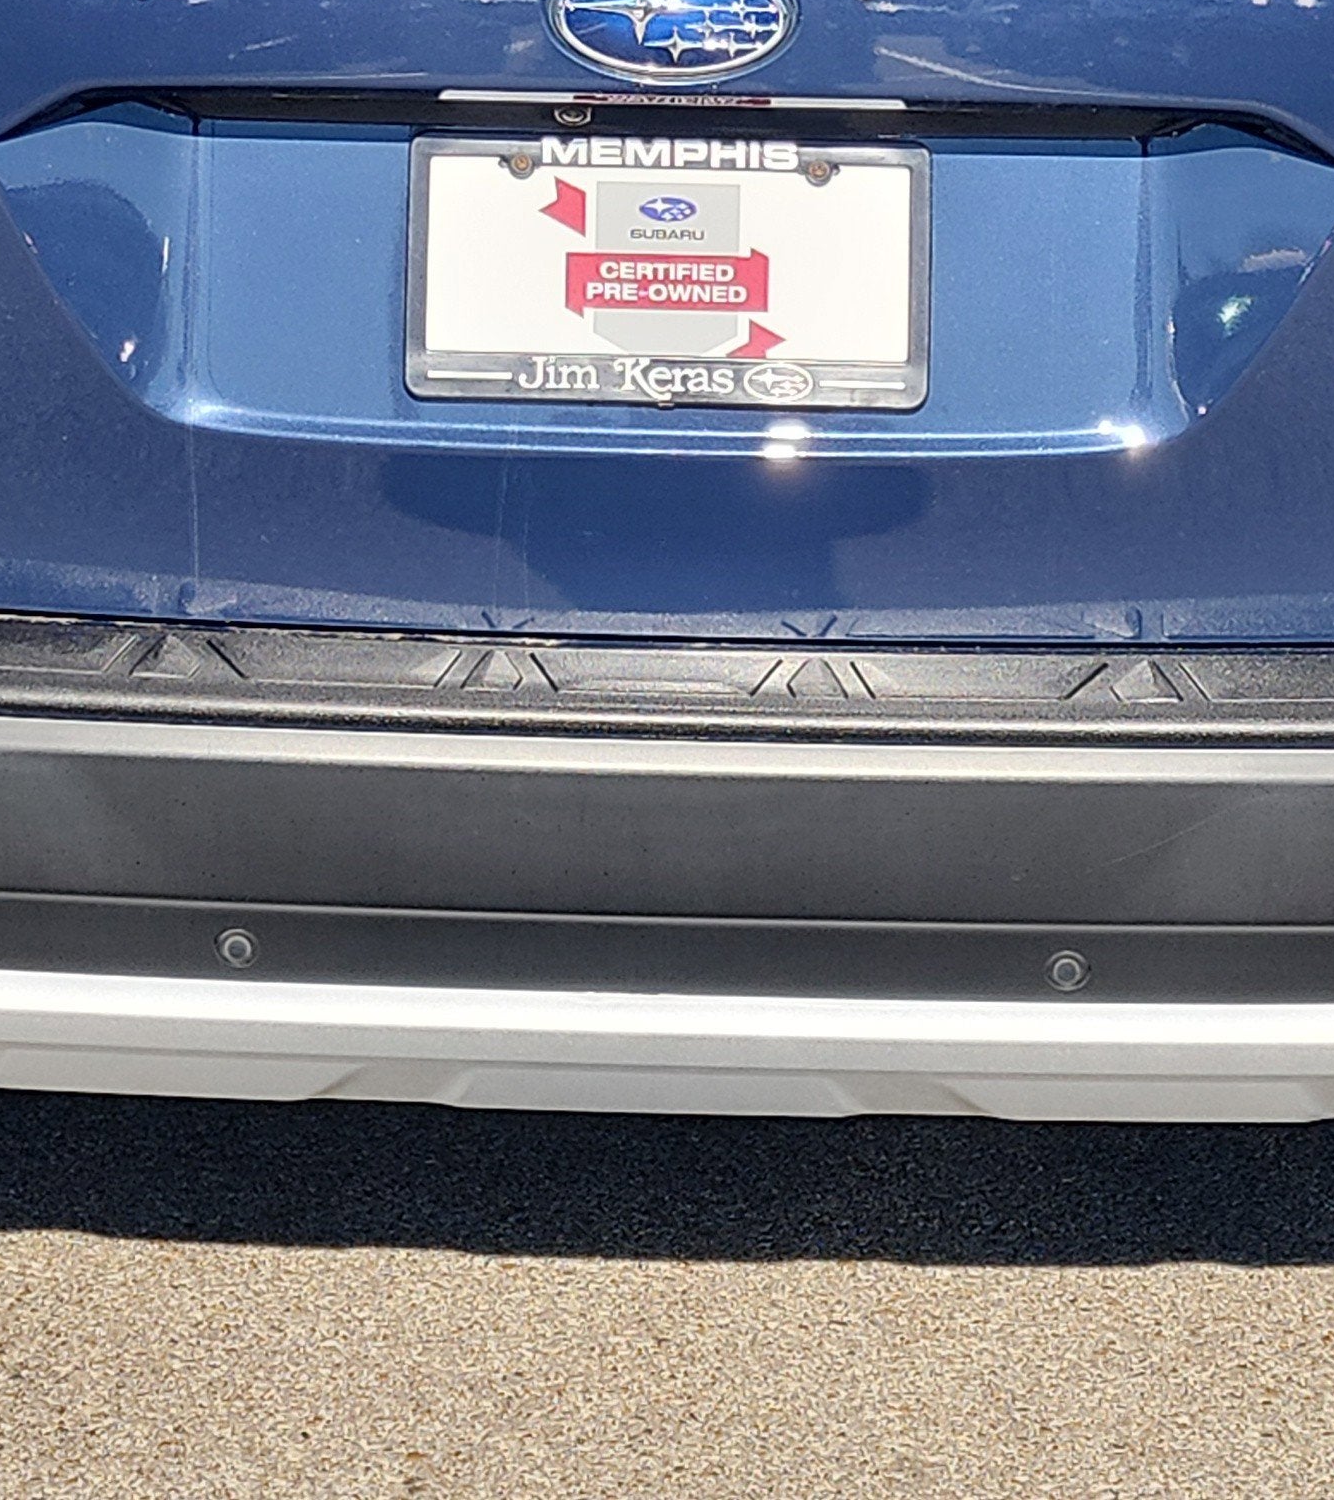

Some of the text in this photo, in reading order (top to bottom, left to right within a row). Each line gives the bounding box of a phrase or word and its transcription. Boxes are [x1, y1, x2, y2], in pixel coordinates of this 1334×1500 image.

[540, 137, 799, 171] MEMPHIS
[629, 228, 705, 242] SUBARU
[599, 260, 735, 283] CERTIFIED
[585, 283, 748, 304] PRE-OWNED
[518, 356, 736, 401] Jim Keras
